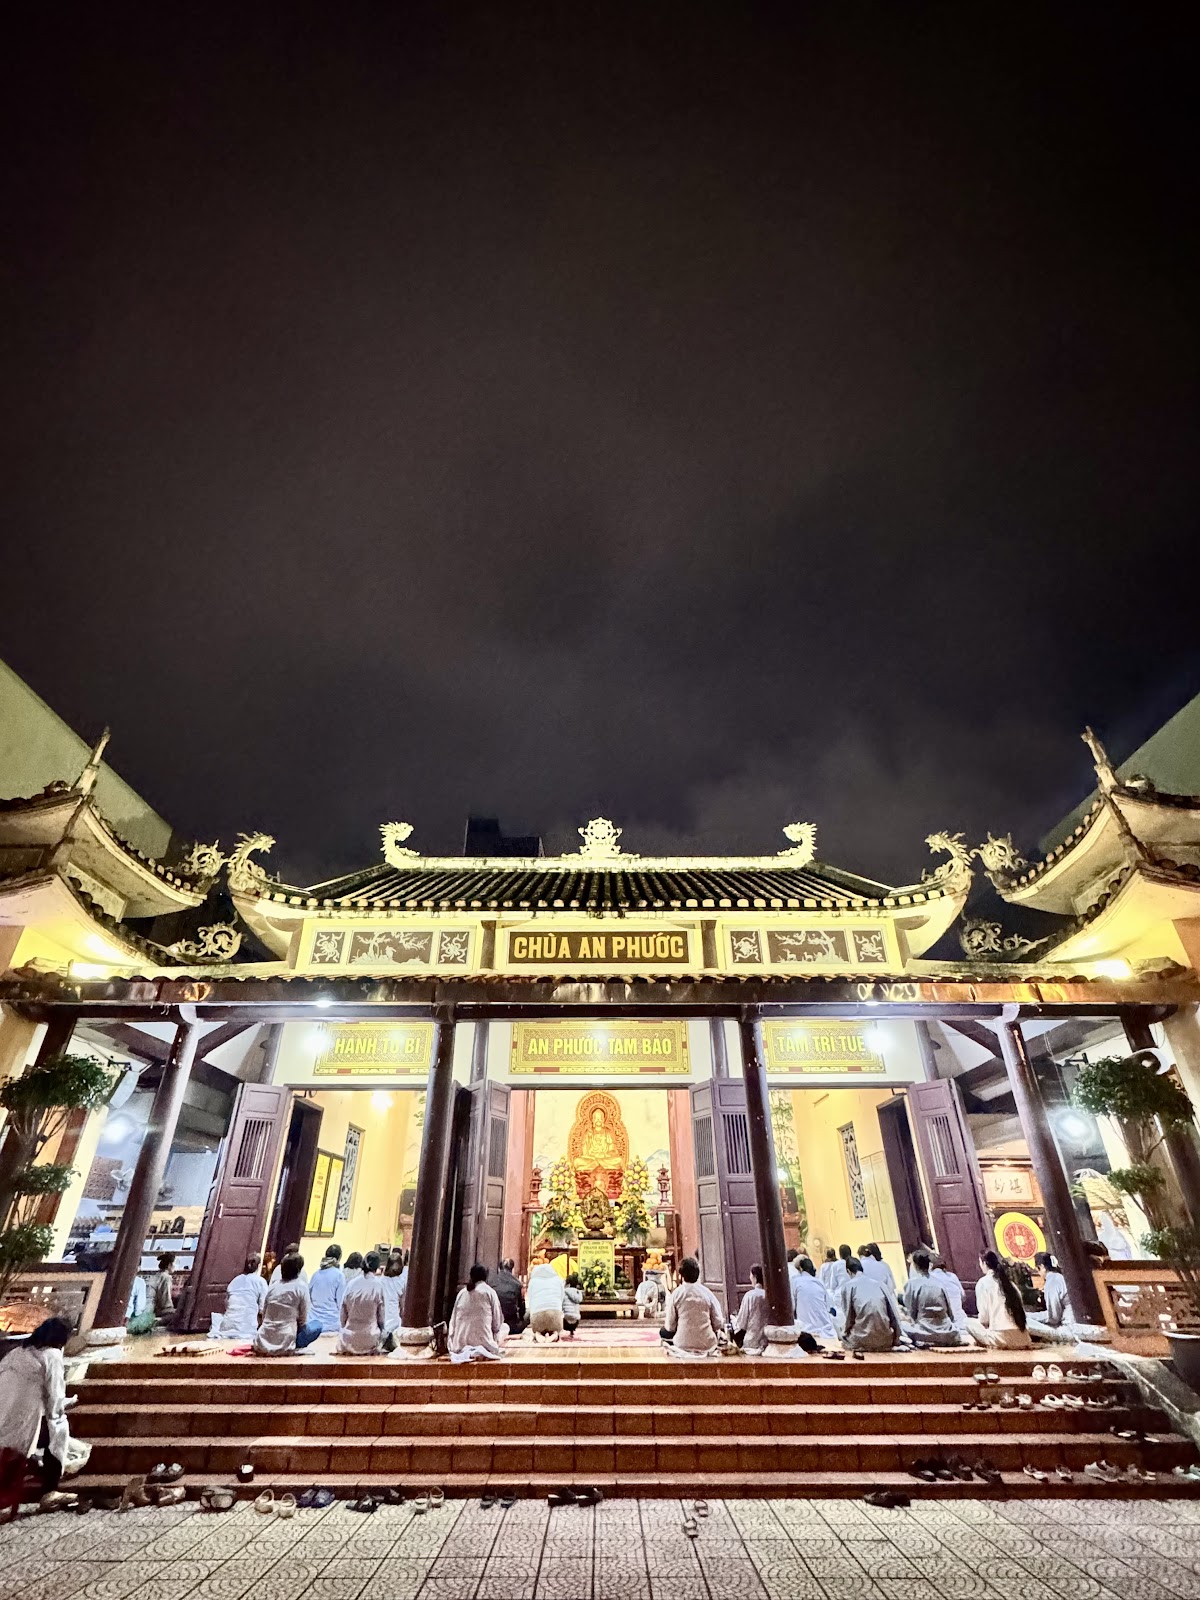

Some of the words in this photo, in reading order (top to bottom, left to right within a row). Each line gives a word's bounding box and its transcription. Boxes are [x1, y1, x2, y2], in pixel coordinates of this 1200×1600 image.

[513, 932, 572, 959] CHÙA
[578, 936, 606, 959] AN
[612, 932, 685, 959] PHƯỚC
[334, 1037, 378, 1058] HẠNH
[404, 1037, 421, 1054] BI
[528, 1038, 549, 1055] AN
[553, 1034, 603, 1055] PHƯỚC
[607, 1038, 638, 1055] TAM
[641, 1033, 672, 1055] BẢO
[776, 1032, 809, 1053] TÂM
